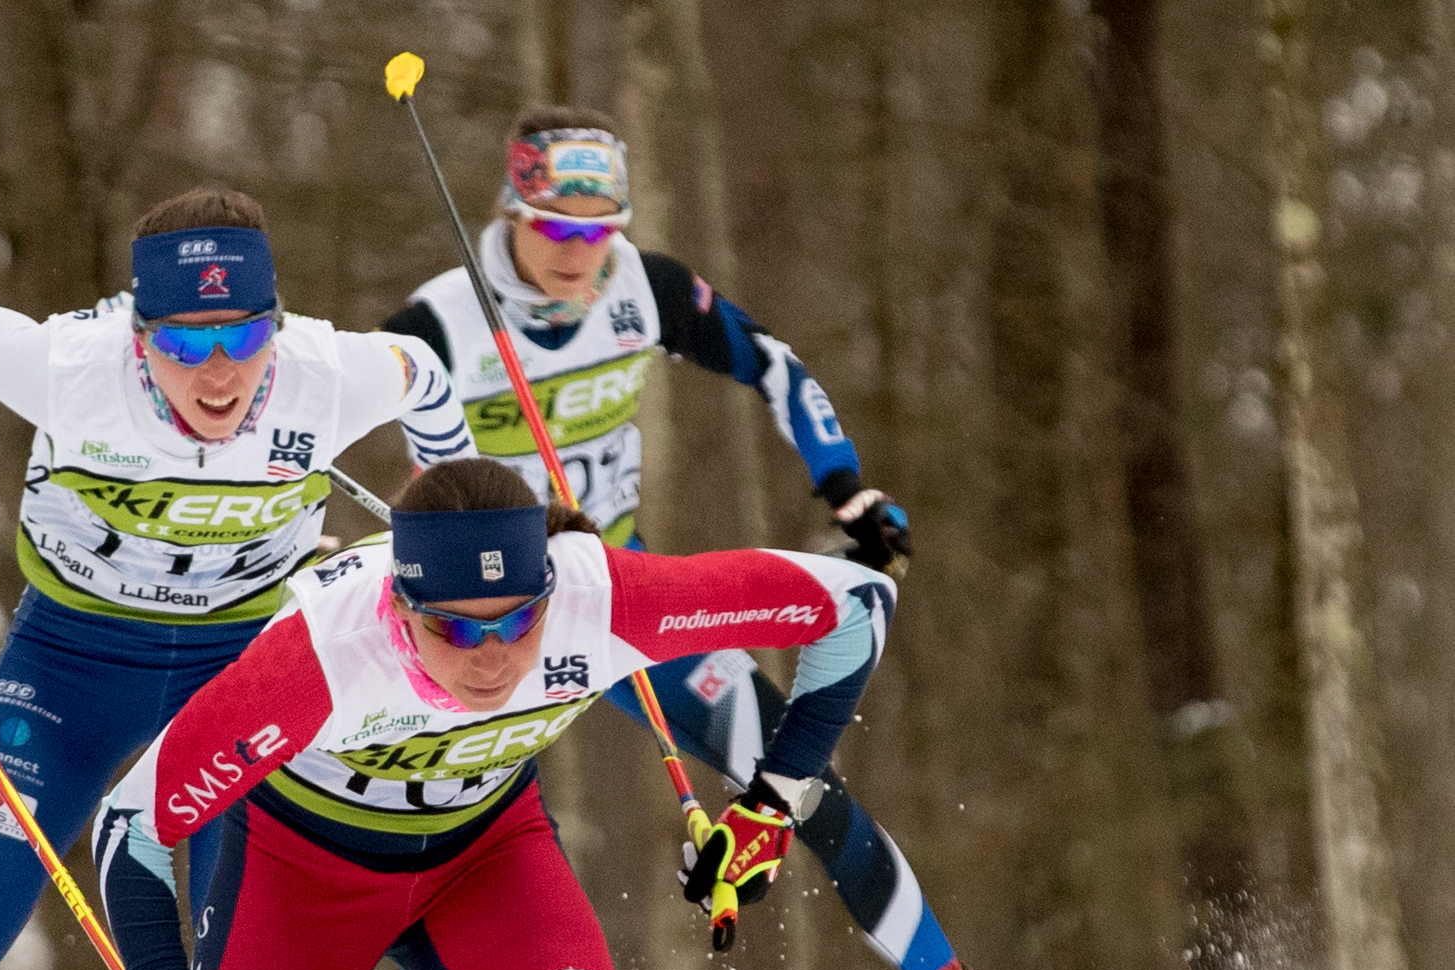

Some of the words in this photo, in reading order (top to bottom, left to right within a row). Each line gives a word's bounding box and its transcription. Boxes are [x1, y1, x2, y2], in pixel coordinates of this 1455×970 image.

[272, 428, 315, 451] US
[483, 552, 500, 562] US
[119, 582, 209, 608] L.L.Bean
[658, 607, 779, 634] podiumwear
[545, 654, 588, 672] US
[730, 830, 771, 876] LEKI
